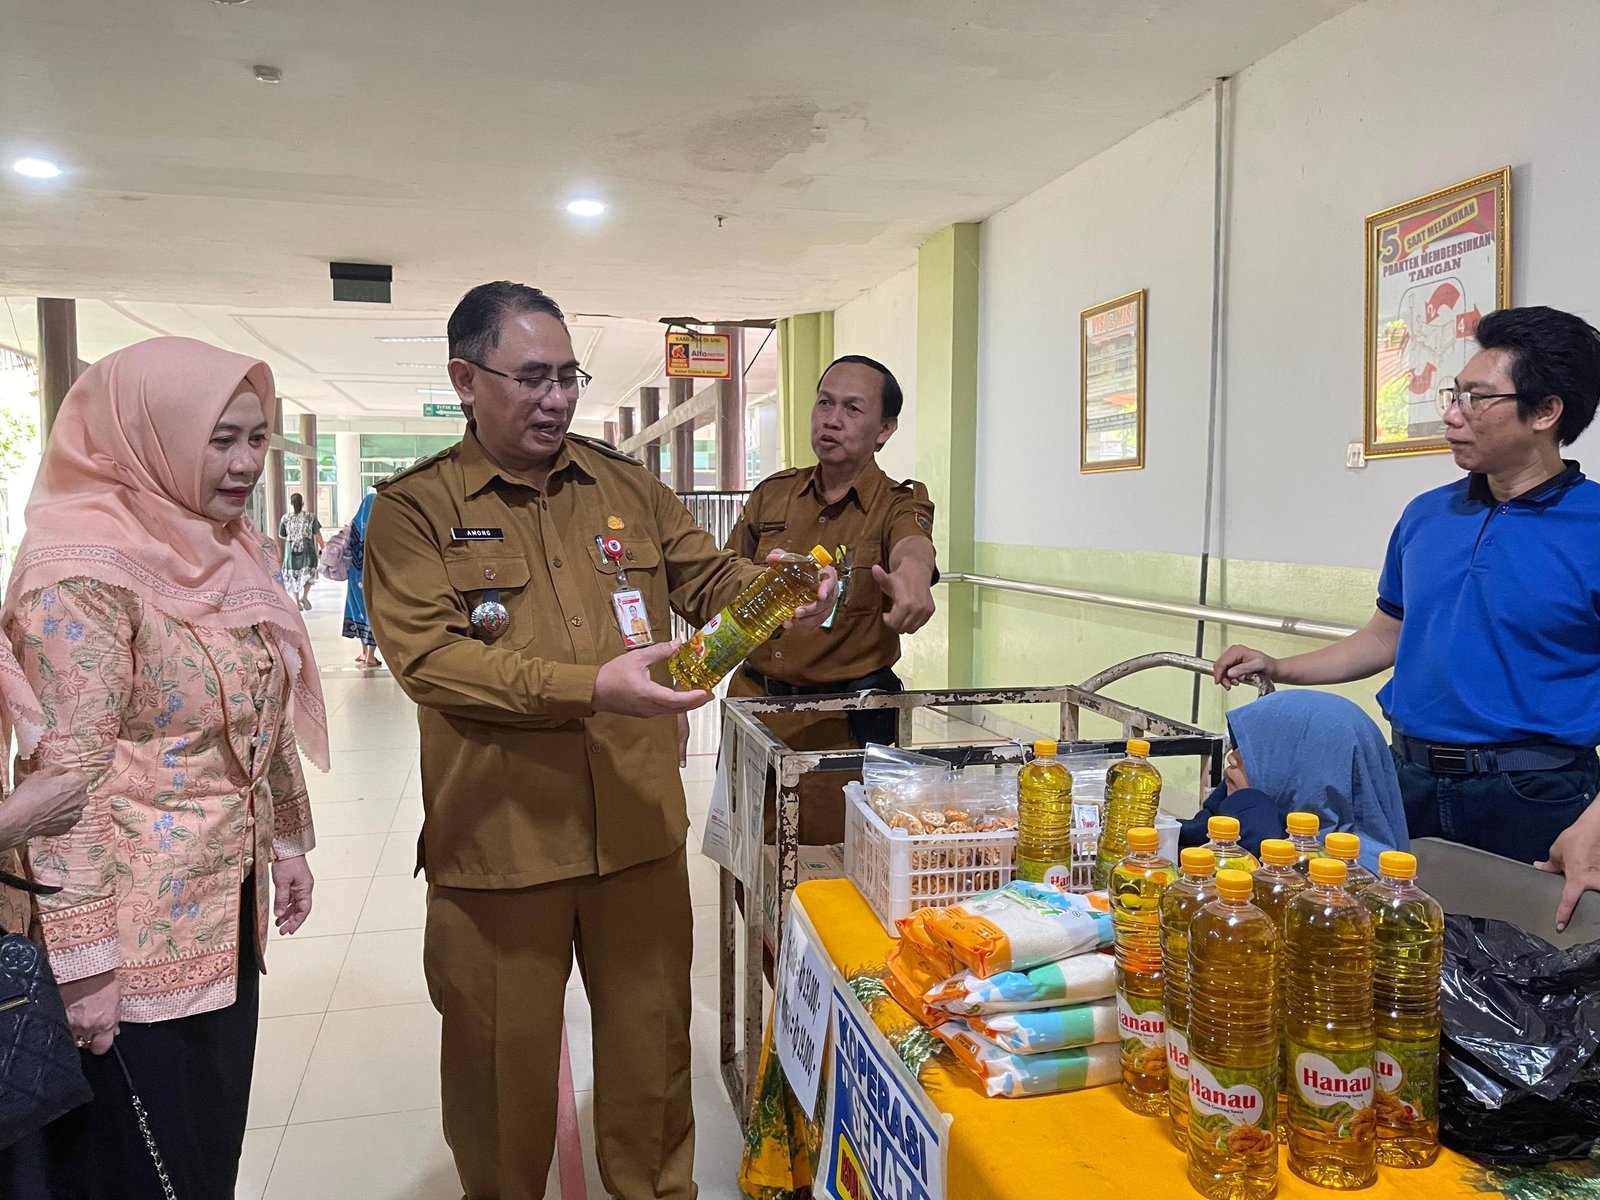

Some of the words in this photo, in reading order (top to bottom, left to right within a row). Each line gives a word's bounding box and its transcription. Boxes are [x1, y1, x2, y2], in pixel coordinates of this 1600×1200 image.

[1405, 229, 1427, 250] SAAT
[1426, 201, 1475, 238] MELAKUKAN
[1380, 226, 1401, 263] 5
[1383, 255, 1420, 278] PRAKTEK
[1420, 232, 1491, 267] MEMBERSIHKAN
[1408, 257, 1462, 282] TANGAN
[1121, 1013, 1164, 1034] anau
[838, 1009, 928, 1186] KOPERASI
[1191, 1074, 1256, 1109] Hanau
[1303, 1067, 1371, 1092] Hanau
